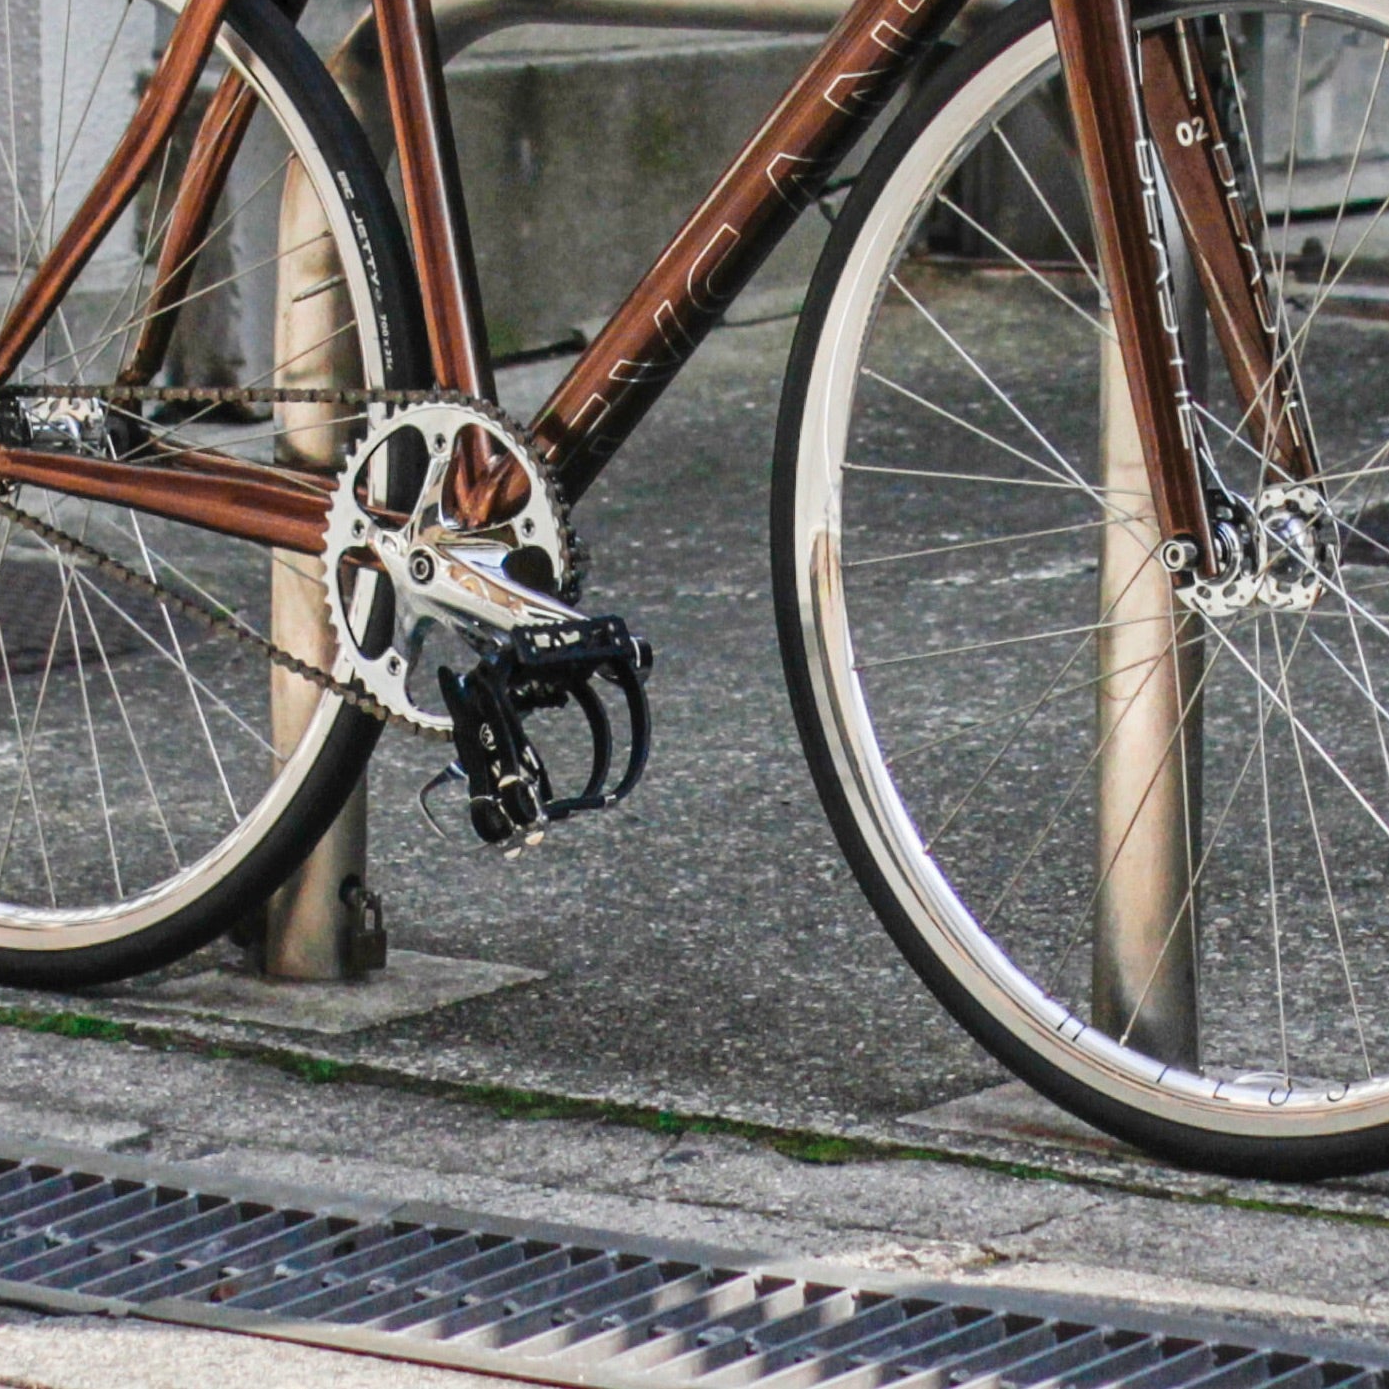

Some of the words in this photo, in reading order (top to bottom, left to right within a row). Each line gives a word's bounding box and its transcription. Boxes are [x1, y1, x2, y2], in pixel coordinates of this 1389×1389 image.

[1175, 116, 1209, 147] 02
[351, 210, 380, 286] JETTY
[378, 314, 390, 338] 700
